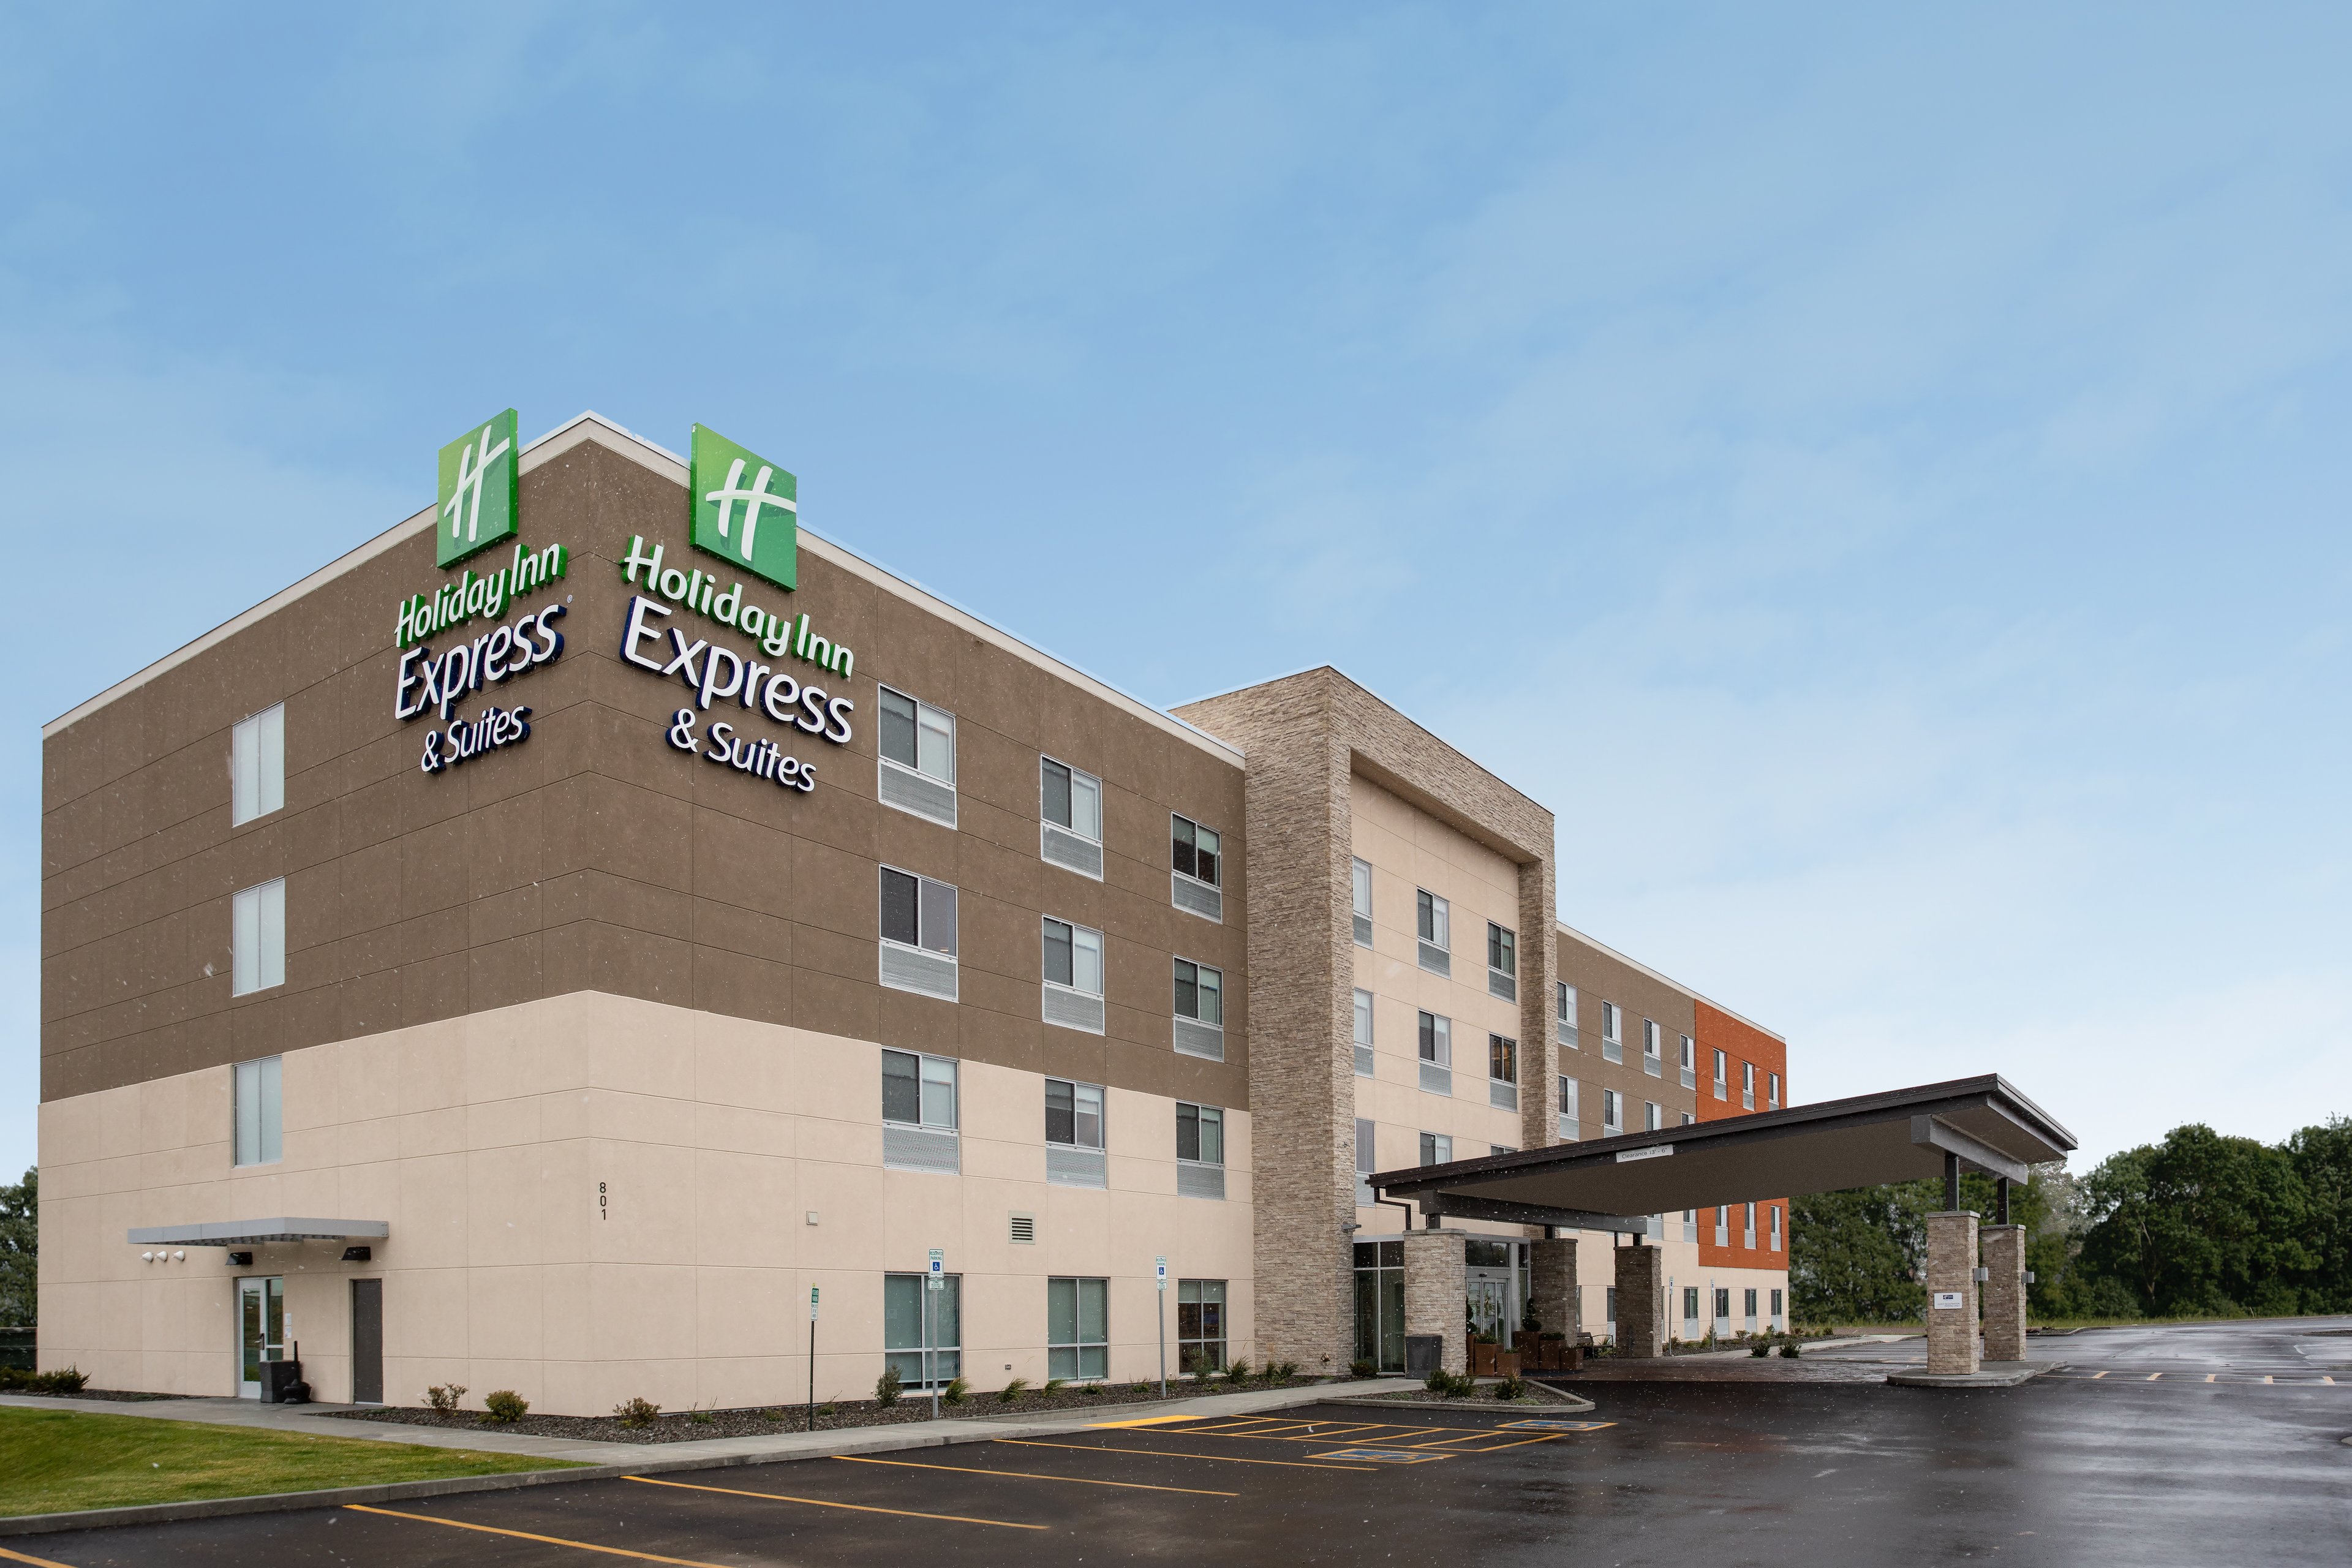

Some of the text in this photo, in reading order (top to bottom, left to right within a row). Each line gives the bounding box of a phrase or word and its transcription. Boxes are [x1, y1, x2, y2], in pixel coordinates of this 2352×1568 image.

[394, 543, 562, 648] Holiday Inn
[622, 534, 854, 678] Holiday Inn
[394, 604, 560, 720] Express
[622, 595, 854, 744] Express
[421, 706, 526, 772] & Suites
[669, 708, 817, 792] & Suites
